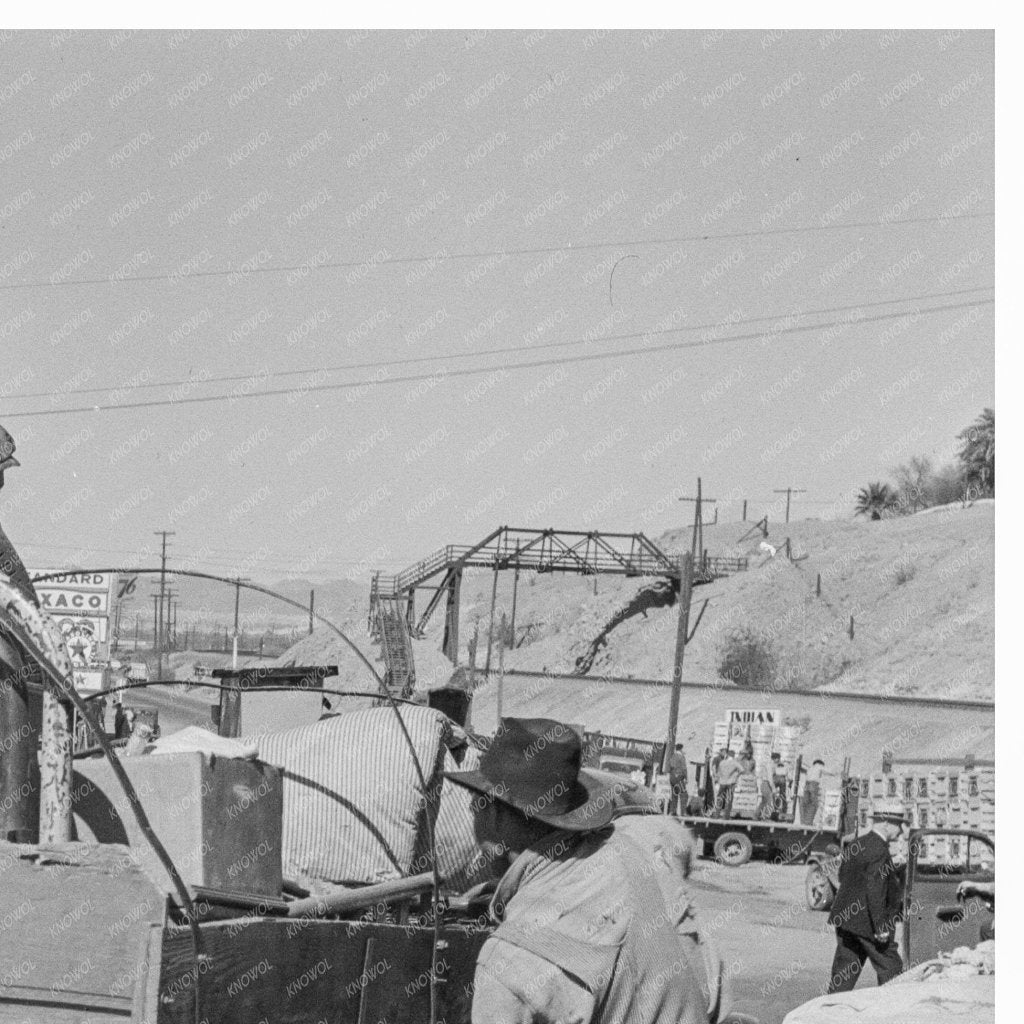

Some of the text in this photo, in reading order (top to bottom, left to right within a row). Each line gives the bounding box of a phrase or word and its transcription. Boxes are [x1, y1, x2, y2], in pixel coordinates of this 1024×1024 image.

[29, 572, 104, 585] ANDARD
[117, 576, 138, 598] 76
[41, 593, 102, 608] XACO
[730, 711, 775, 723] INDIAN
